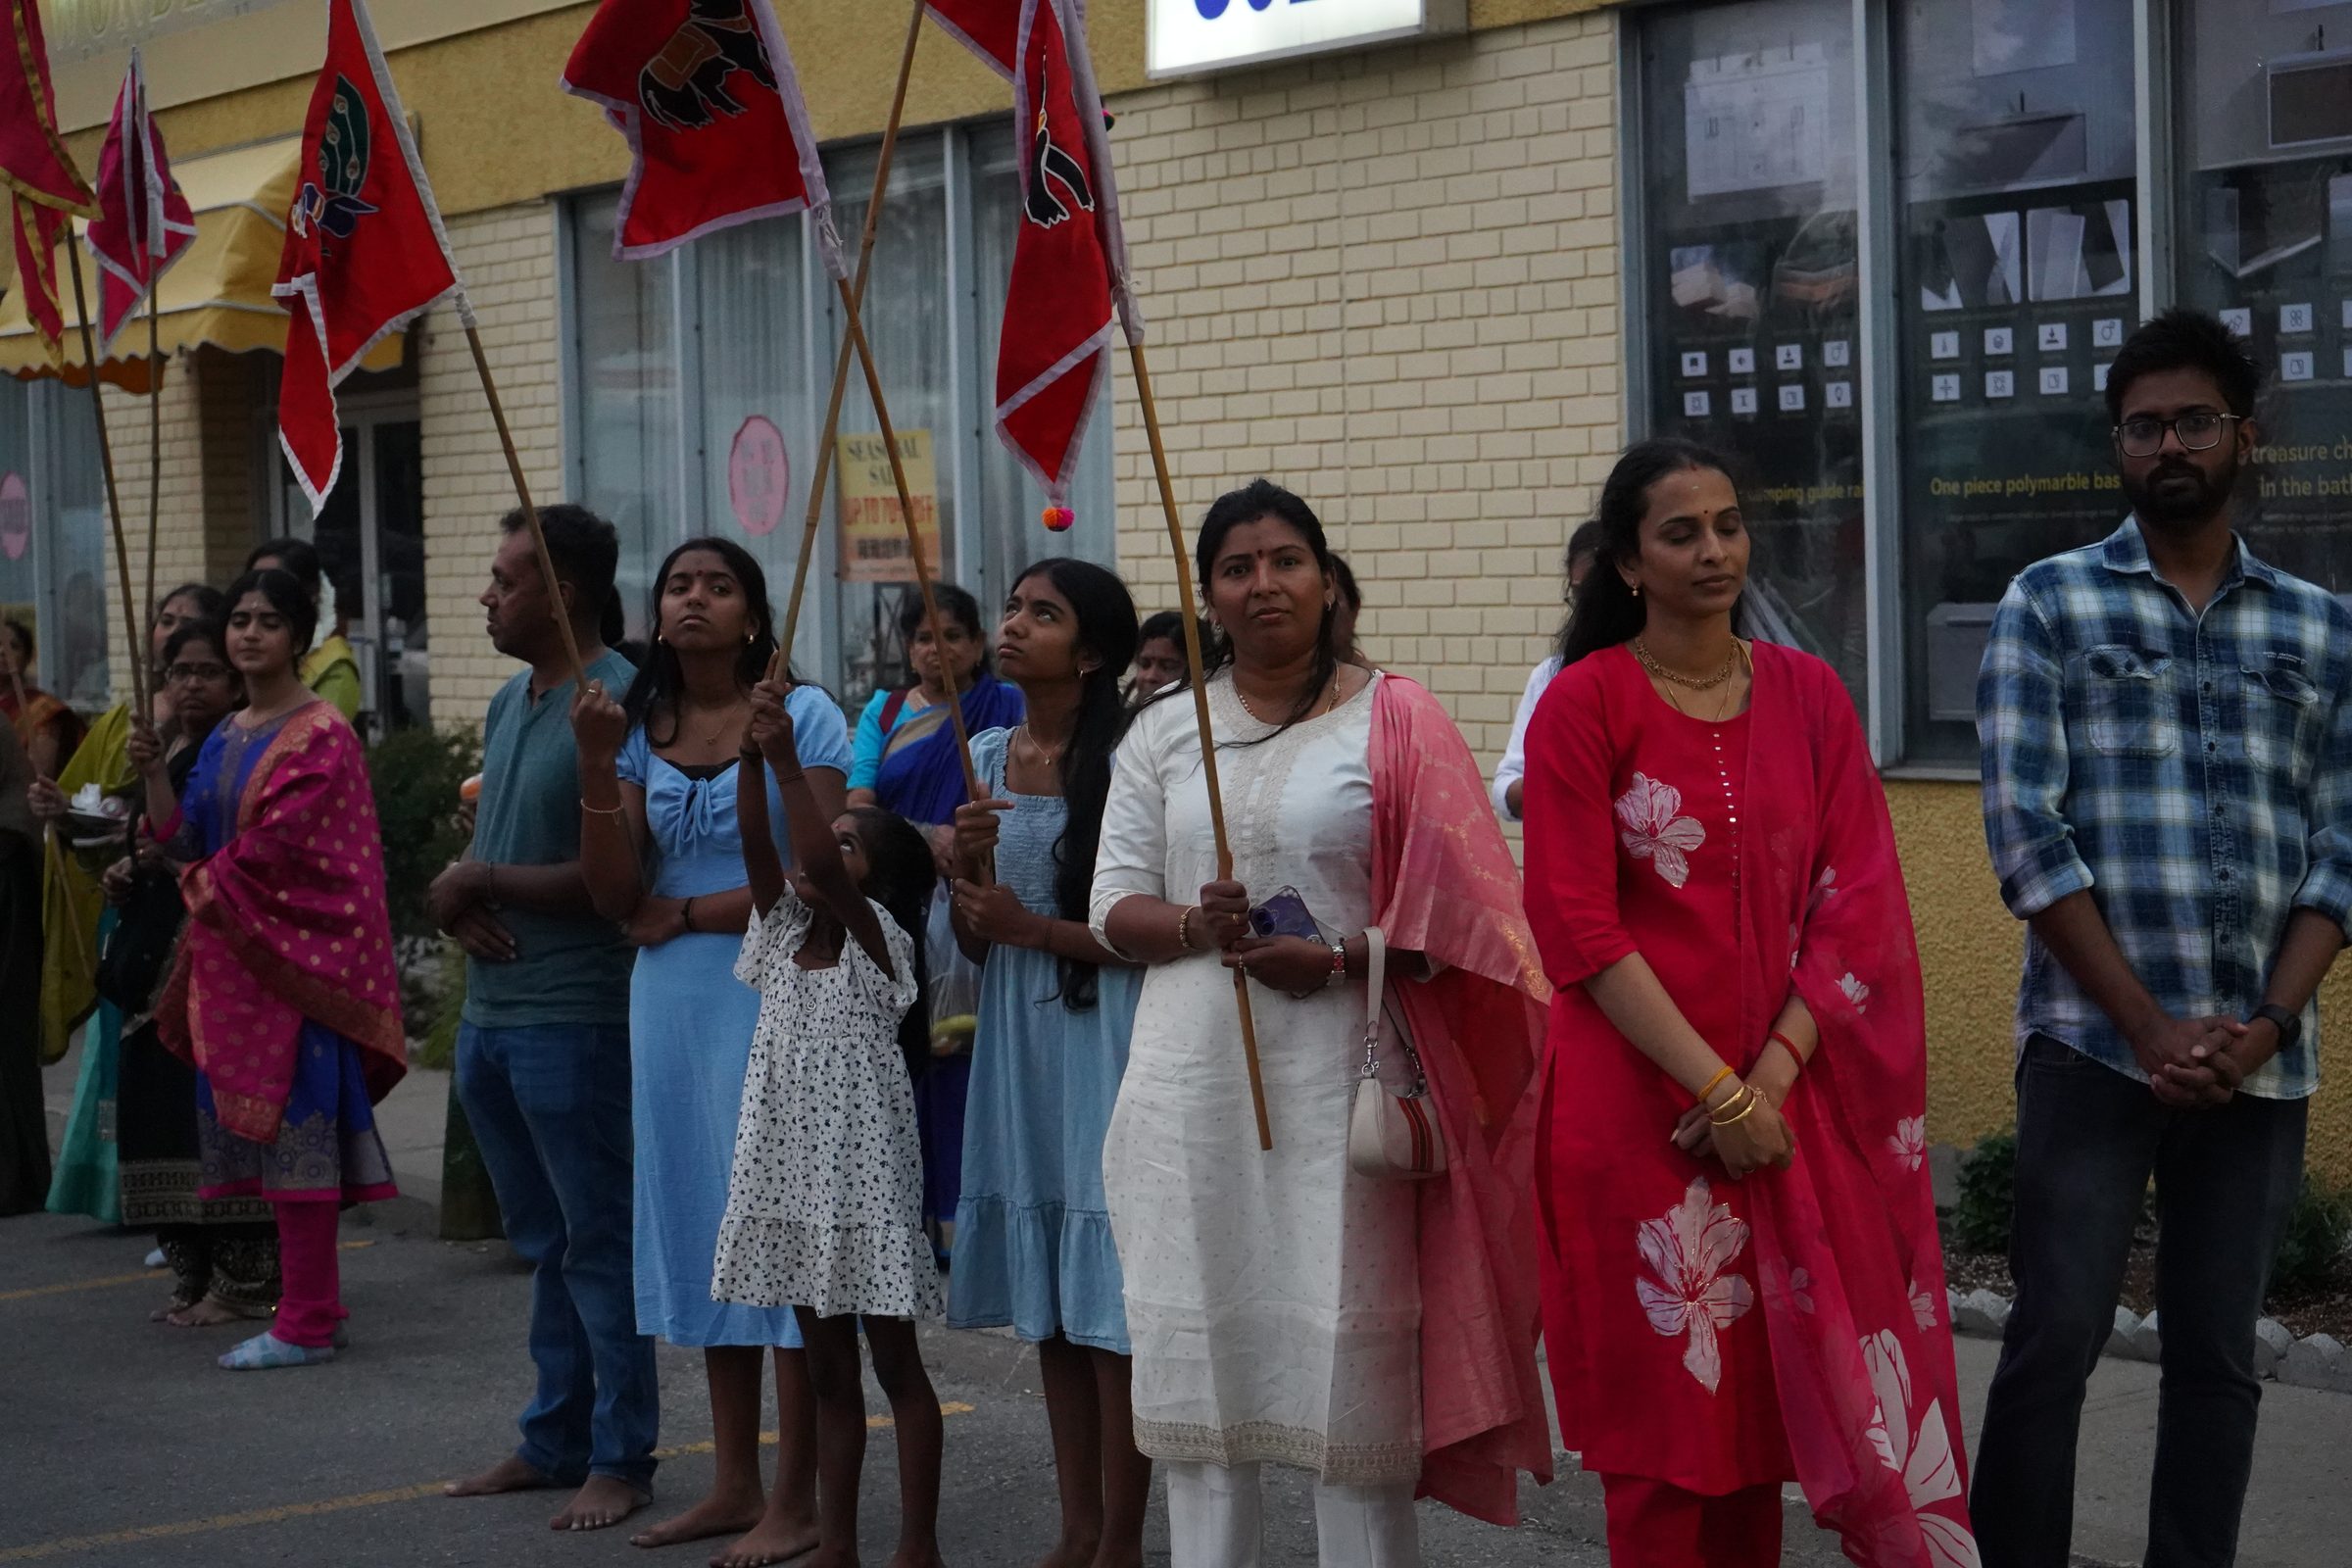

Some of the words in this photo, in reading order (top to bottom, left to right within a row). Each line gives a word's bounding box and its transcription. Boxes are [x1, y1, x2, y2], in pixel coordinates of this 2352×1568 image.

[847, 438, 921, 462] SEASAL
[2252, 445, 2328, 464] treasure
[868, 464, 900, 486] SAL
[1930, 476, 1960, 496] One
[1964, 475, 2002, 499] piece
[2006, 472, 2089, 498] polymarble
[2282, 475, 2312, 497] the
[1807, 480, 1844, 504] guide
